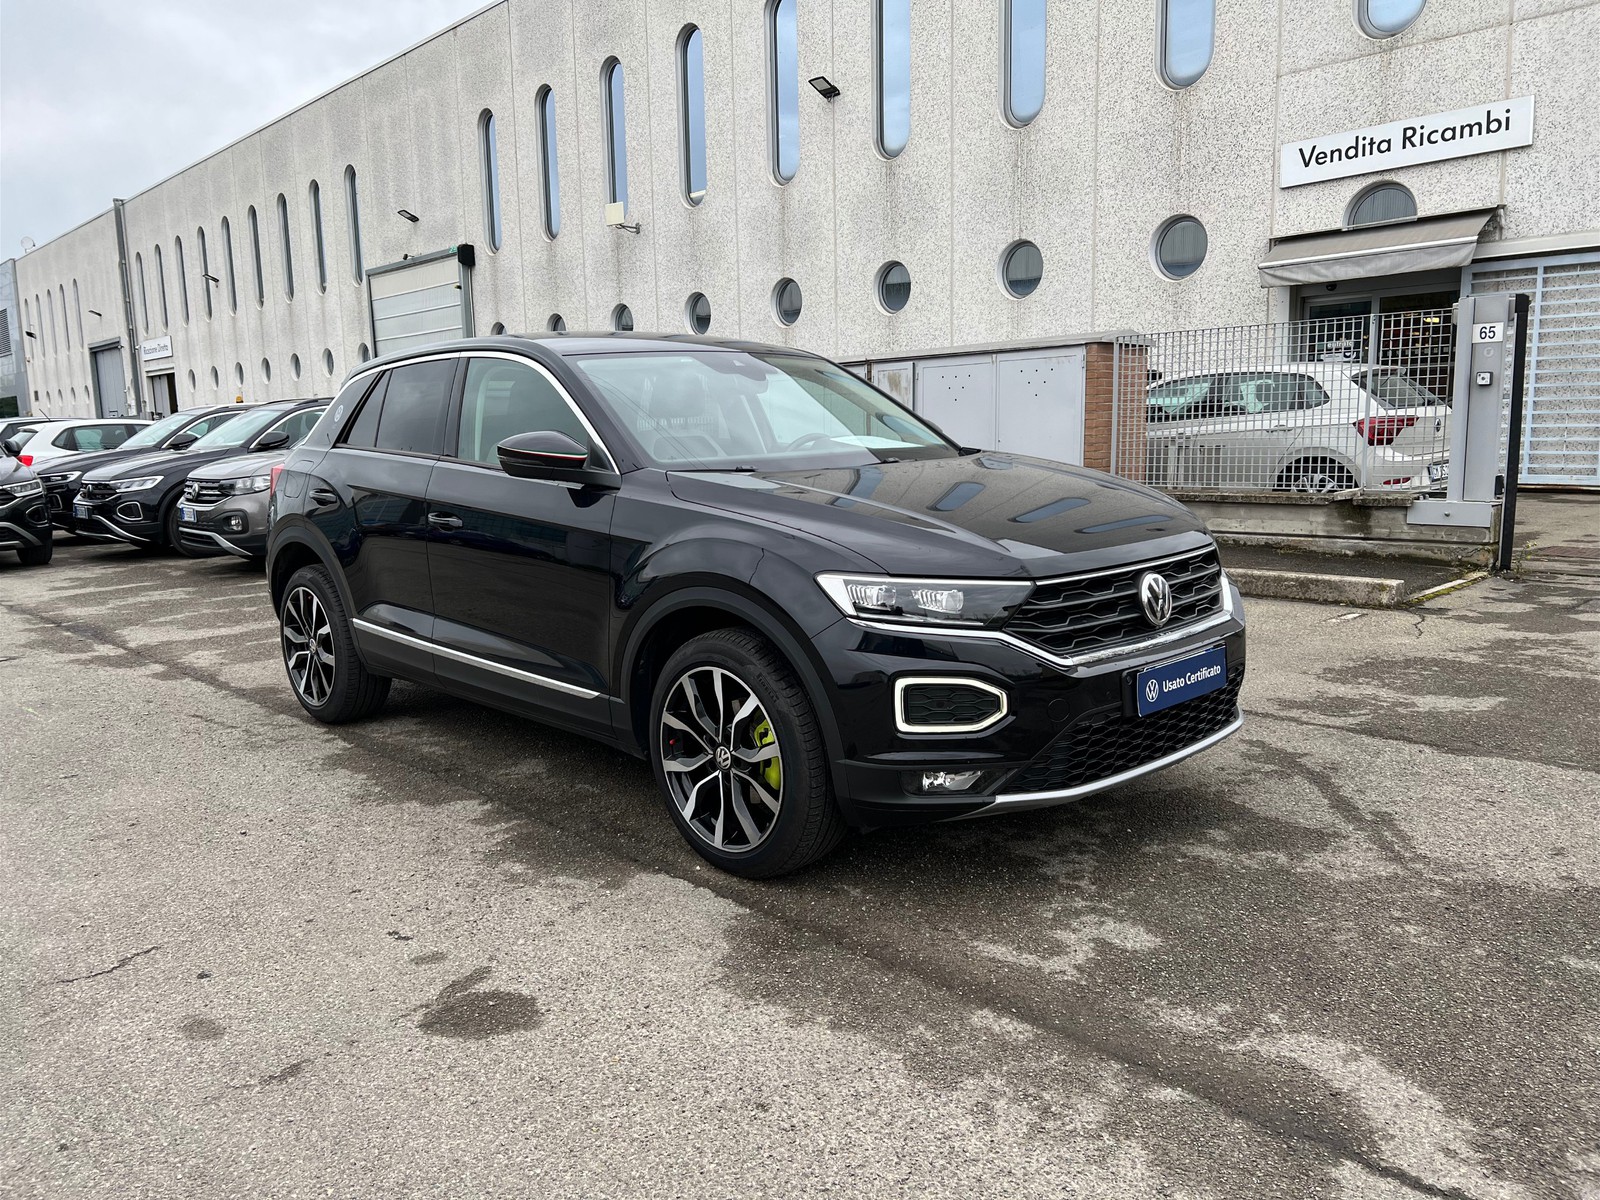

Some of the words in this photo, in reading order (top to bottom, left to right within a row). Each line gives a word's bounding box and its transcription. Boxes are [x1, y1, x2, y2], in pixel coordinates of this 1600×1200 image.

[1299, 135, 1392, 168] Vendita
[1402, 108, 1511, 150] Ricambi
[1479, 325, 1496, 340] 65
[1162, 677, 1185, 692] Usato
[1186, 665, 1221, 685] Certificato
